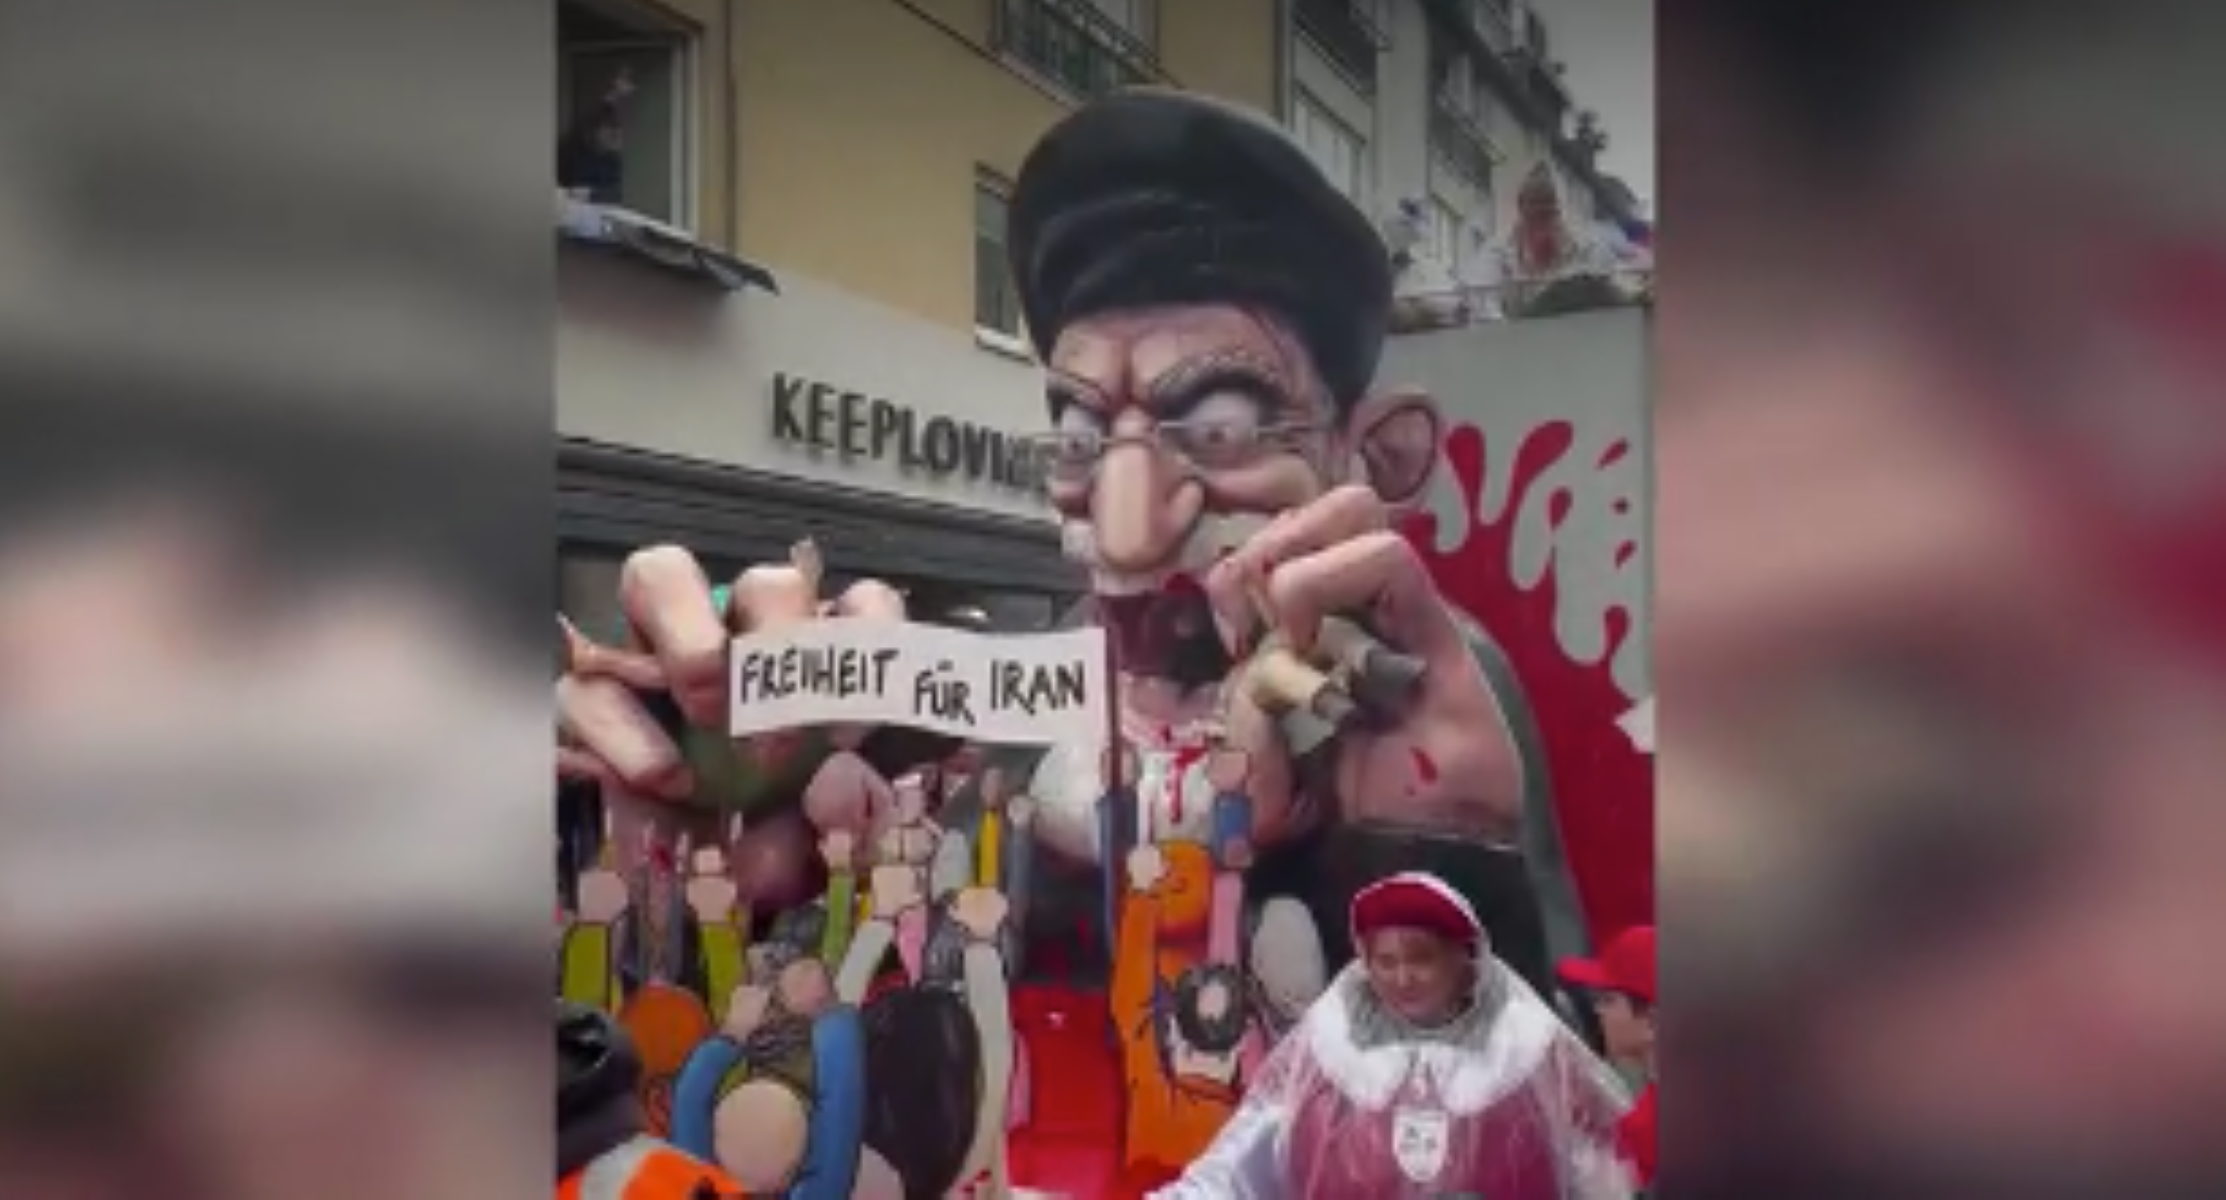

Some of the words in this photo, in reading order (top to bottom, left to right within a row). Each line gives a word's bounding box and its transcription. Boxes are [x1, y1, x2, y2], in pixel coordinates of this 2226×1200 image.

[740, 645, 899, 703] FREIHEIT
[913, 661, 976, 726] FÜR
[990, 659, 1085, 716] IRAN
